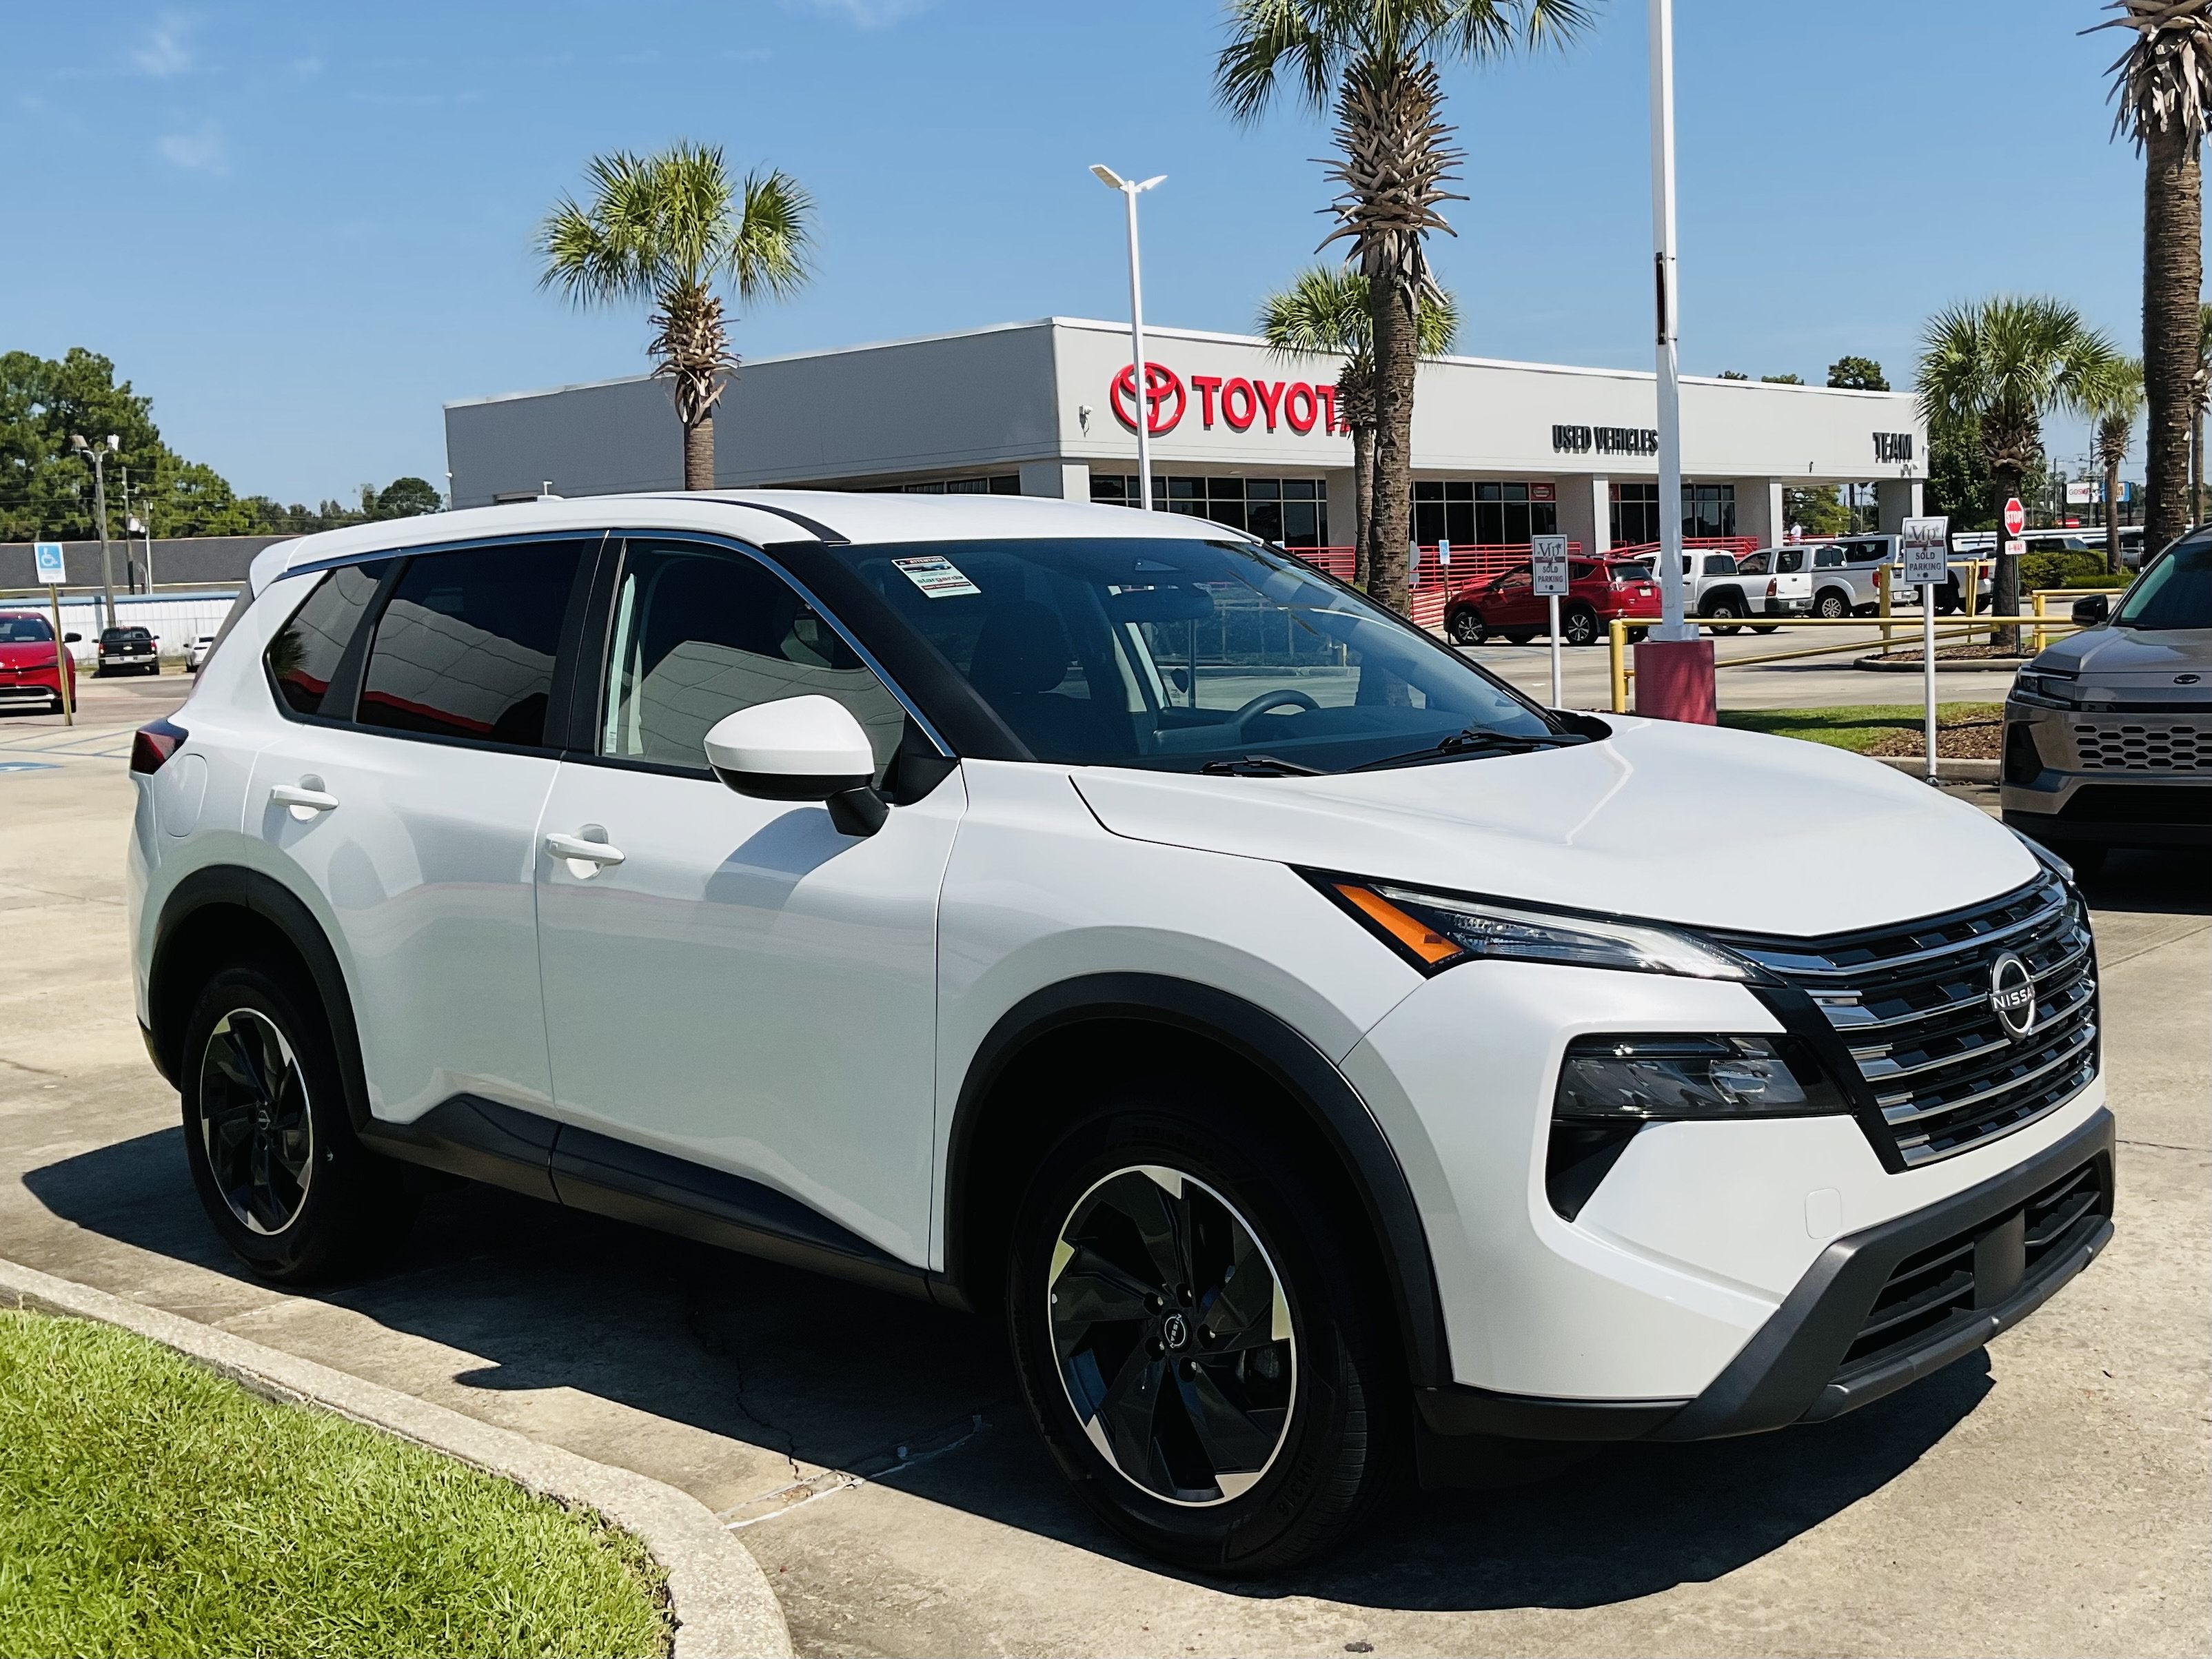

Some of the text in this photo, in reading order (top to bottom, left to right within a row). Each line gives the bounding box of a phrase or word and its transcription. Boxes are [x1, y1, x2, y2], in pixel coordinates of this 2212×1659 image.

[1191, 376, 1351, 432] TOYOT
[1552, 425, 1658, 452] USED VEHICLES
[1873, 432, 1912, 460] TEAM
[2007, 511, 2022, 524] STOP
[1909, 562, 1941, 571] PARKING
[1992, 986, 2034, 1008] NISSA
